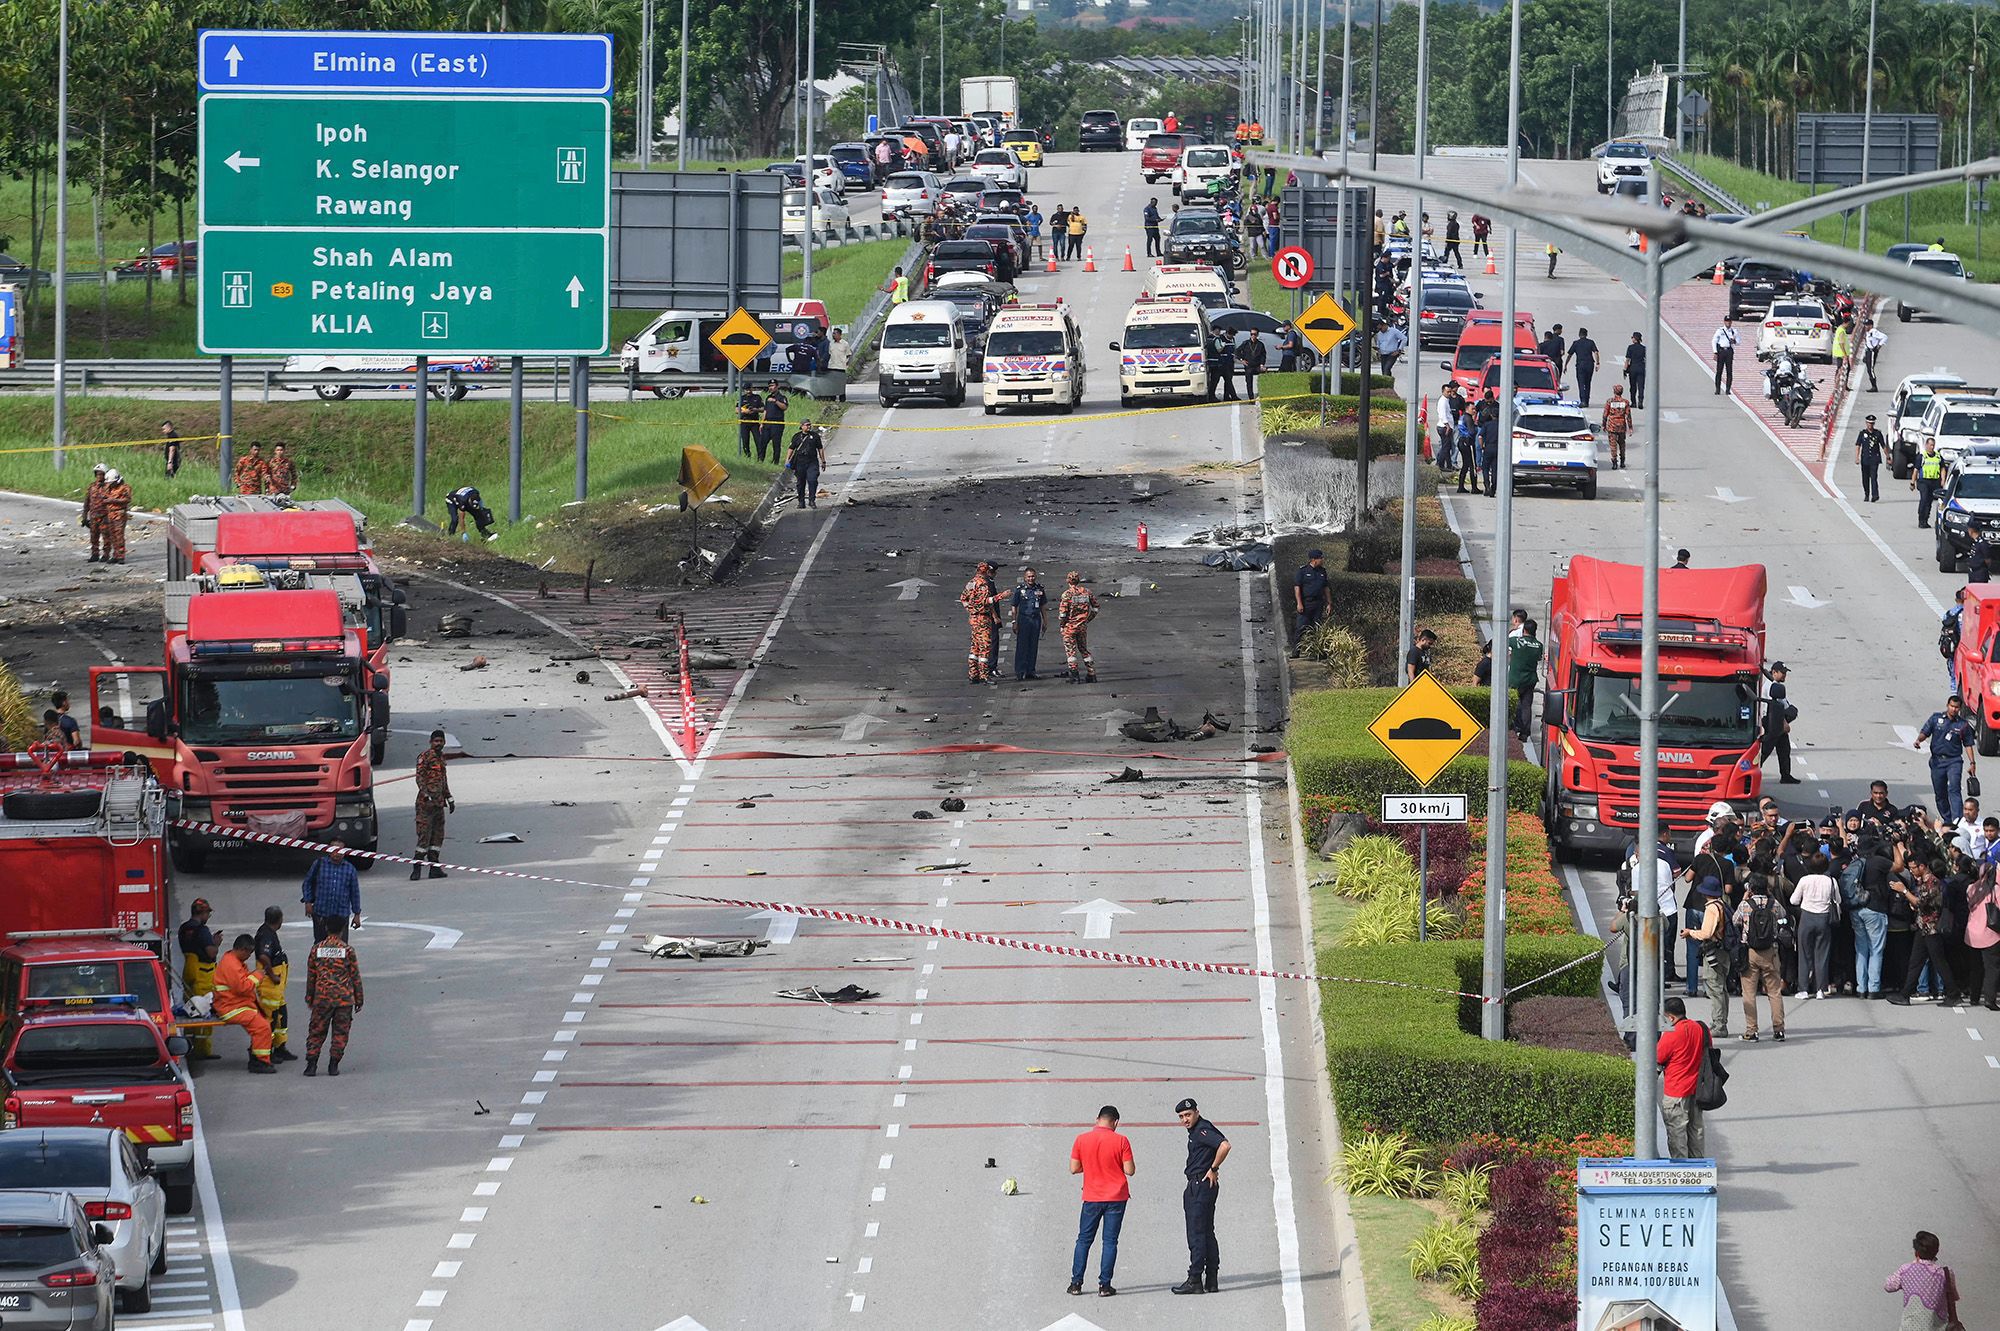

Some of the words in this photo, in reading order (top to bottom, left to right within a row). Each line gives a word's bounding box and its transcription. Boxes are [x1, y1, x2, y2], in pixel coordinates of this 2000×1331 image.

[314, 52, 396, 73] Elmina
[412, 53, 488, 78] (East)
[316, 123, 367, 147] Ipoh
[316, 159, 340, 179] K.
[351, 159, 460, 184] Selangor
[316, 196, 412, 221] Rawang
[313, 247, 373, 267] Shah
[388, 248, 453, 267] Alam
[274, 286, 291, 294] E35
[312, 280, 415, 307] Petaling
[430, 281, 492, 306] Jaya
[312, 315, 373, 334] KLIA
[1658, 634, 1692, 642] OMBA
[247, 751, 296, 760] SCANIA
[1633, 751, 1694, 764] SANIA
[1639, 1171, 1681, 1179] ADVERTISING
[1599, 1207, 1647, 1219] ELMINA
[1655, 1207, 1695, 1219] GREEN
[1599, 1223, 1694, 1248] SEVEN
[1602, 1262, 1653, 1273] PEGANGAN
[1658, 1262, 1689, 1273] BEBAS
[1591, 1276, 1614, 1287] DARI
